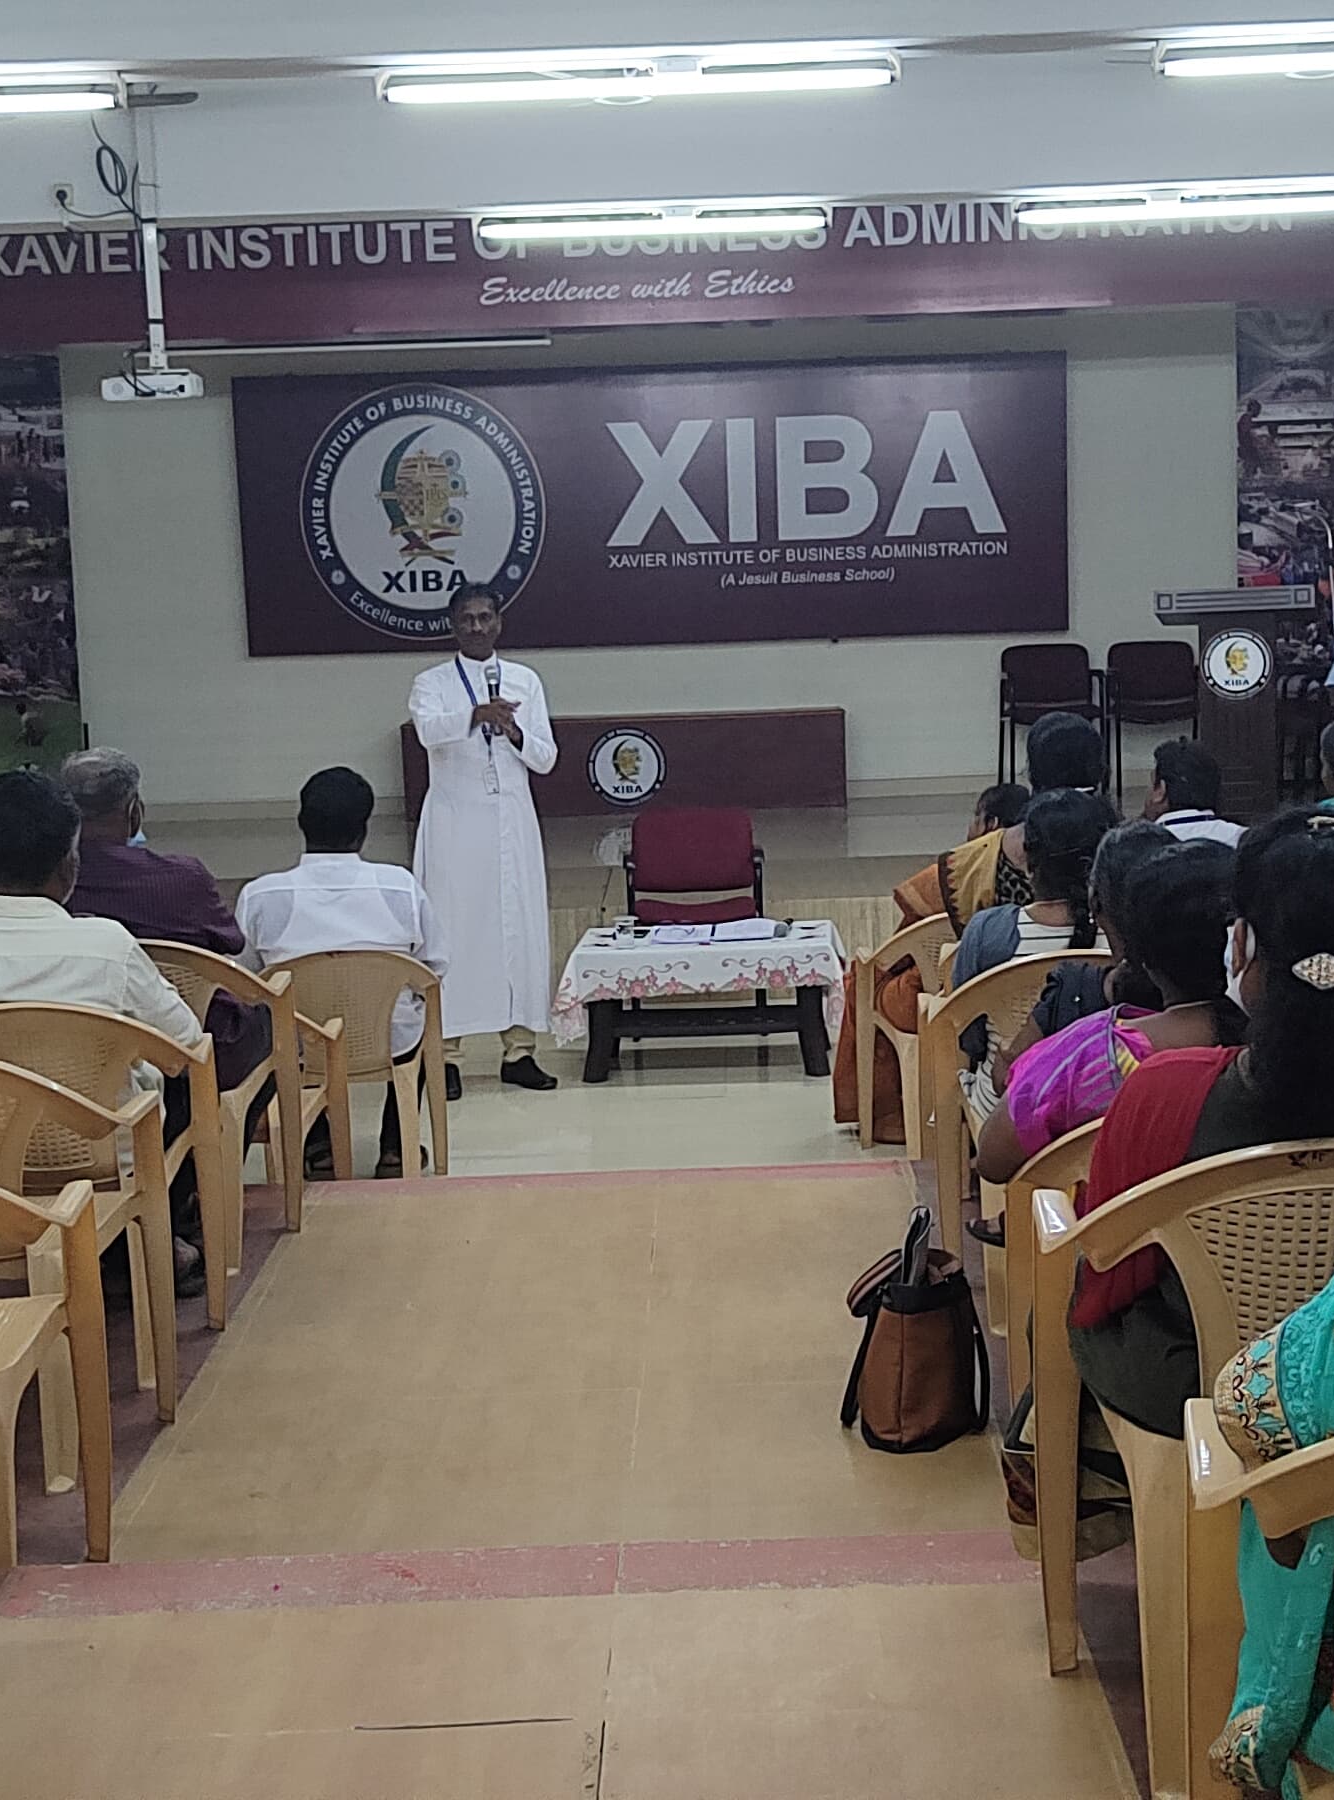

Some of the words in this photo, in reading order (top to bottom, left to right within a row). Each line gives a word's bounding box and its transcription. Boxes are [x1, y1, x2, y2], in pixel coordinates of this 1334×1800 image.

[188, 221, 457, 270] INSTITUTE
[479, 276, 621, 306] Excellence
[630, 271, 693, 298] with
[703, 268, 796, 298] Ethics
[366, 402, 386, 421] OF
[392, 394, 473, 420] BUSINESS
[313, 416, 365, 491] INSTITUTE
[475, 416, 535, 554] ADMINISTRATION
[605, 409, 1008, 548] XIBA
[312, 497, 335, 560] XAVIER
[608, 552, 667, 569] XAVIER
[671, 550, 755, 566] INSTITUTE
[759, 548, 781, 563] OF
[786, 545, 867, 562] BUSINESS
[871, 541, 1008, 559] ADMINISTRATION
[382, 569, 468, 594] XIBA
[738, 571, 777, 586] Jesuit
[781, 570, 841, 584] Business
[844, 567, 895, 582] School)
[350, 591, 424, 631] Excellence
[428, 616, 452, 632] wit
[612, 785, 643, 794] XIBA
